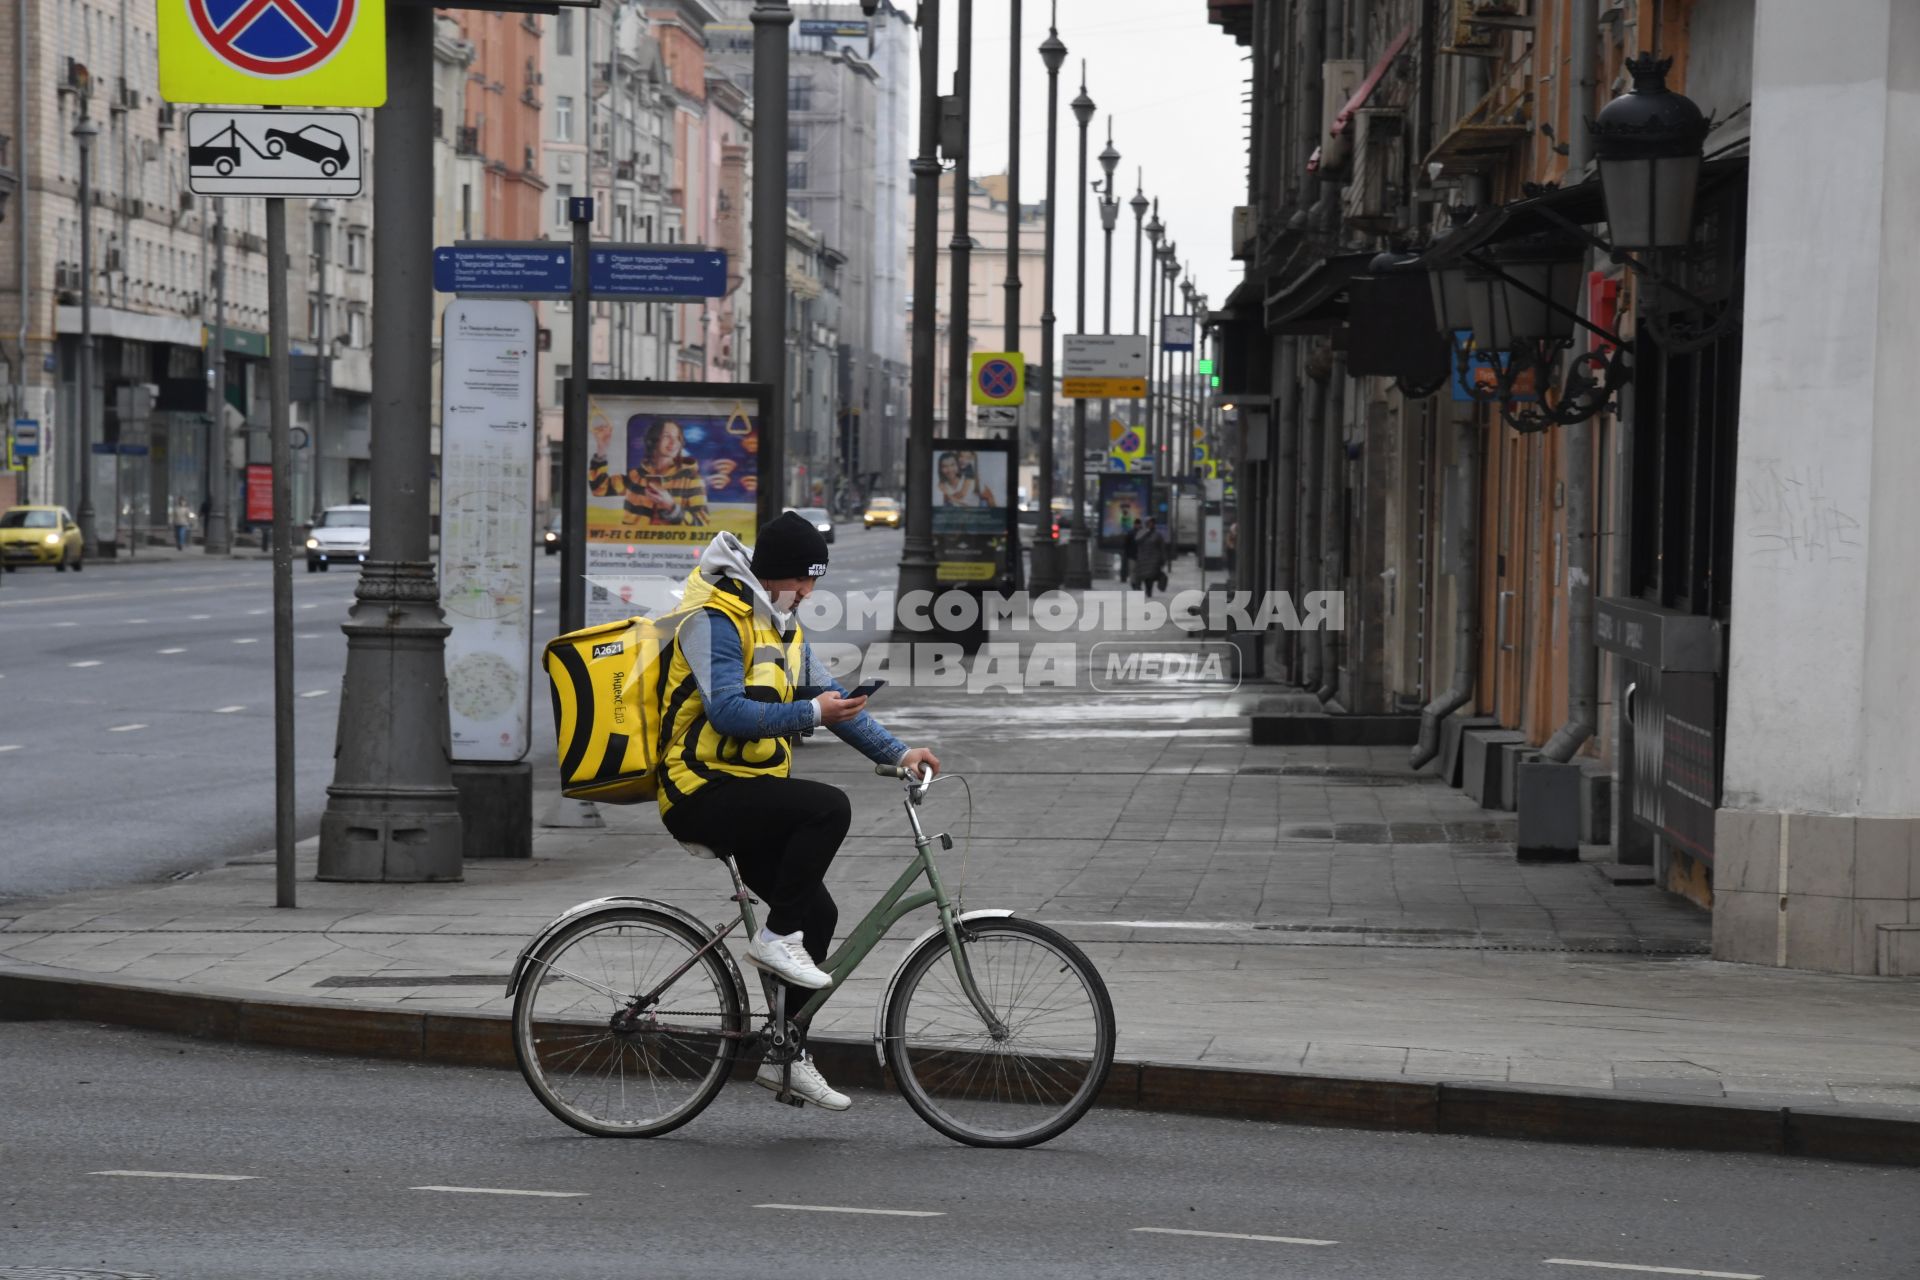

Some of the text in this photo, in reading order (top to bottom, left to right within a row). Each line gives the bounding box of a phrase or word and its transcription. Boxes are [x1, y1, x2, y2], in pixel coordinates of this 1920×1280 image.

[589, 529, 622, 539] WI-FI
[635, 531, 687, 540] ПЕРВОГО
[690, 531, 743, 541] ВЗГА
[594, 643, 622, 657] A2621
[612, 671, 625, 705] Яндекс
